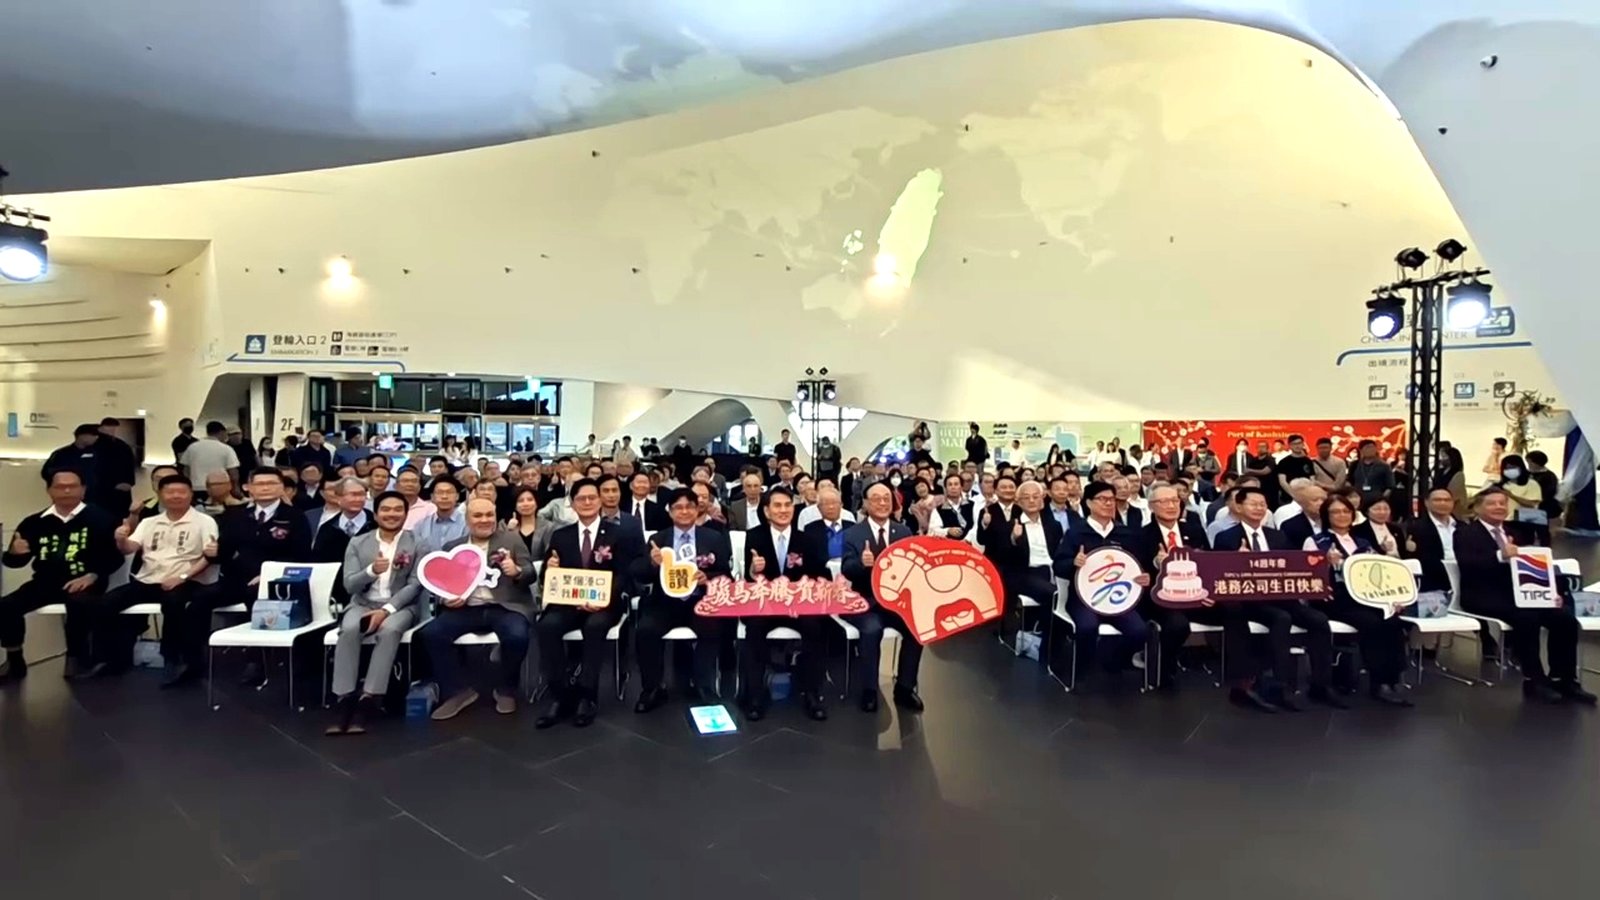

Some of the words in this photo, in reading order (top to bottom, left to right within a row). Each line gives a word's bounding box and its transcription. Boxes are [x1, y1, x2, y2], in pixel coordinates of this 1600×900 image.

[273, 334, 316, 345] 登輪入口
[320, 336, 327, 345] 2
[280, 417, 294, 431] 2F
[562, 574, 606, 586] 整個港口
[668, 568, 690, 590] 讚
[706, 575, 856, 610] 駿馬奔騰賀新春
[1214, 578, 1325, 595] 港務公司生日快樂
[1362, 588, 1396, 599] Taiwan
[1520, 590, 1552, 601] TIPC
